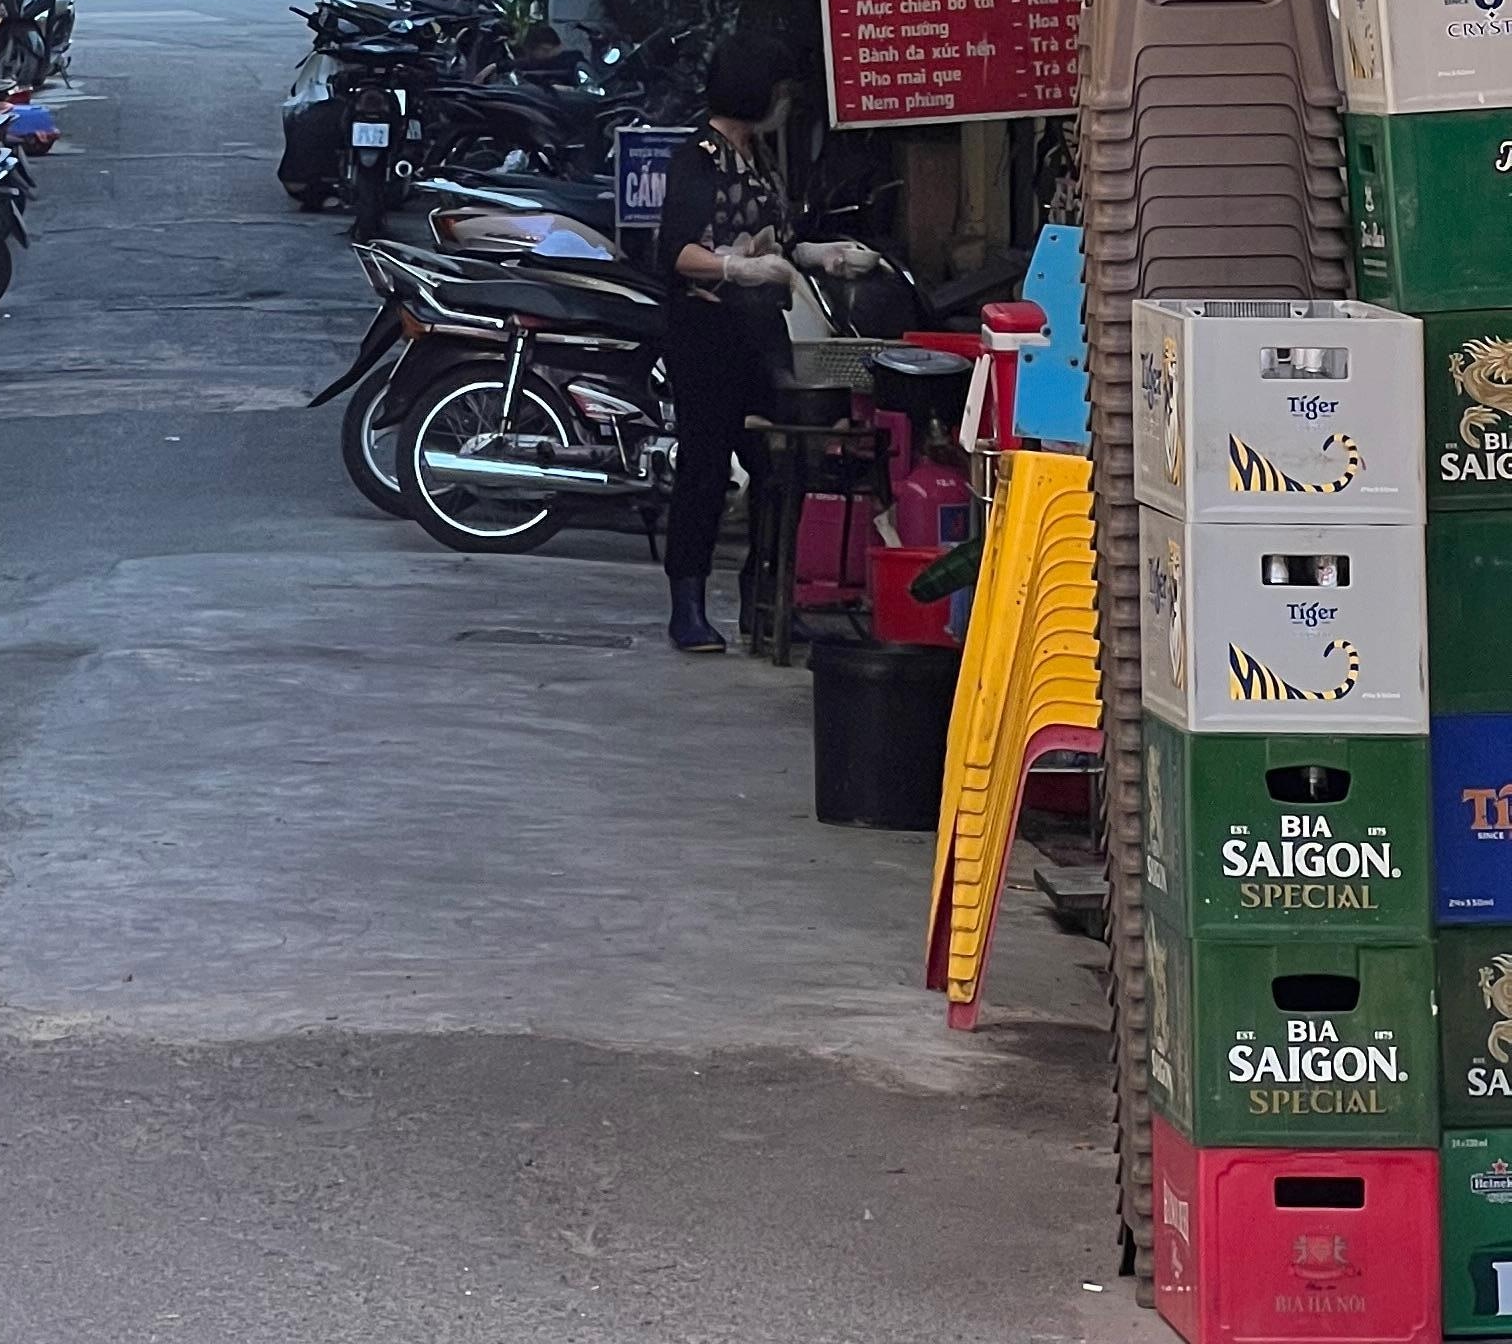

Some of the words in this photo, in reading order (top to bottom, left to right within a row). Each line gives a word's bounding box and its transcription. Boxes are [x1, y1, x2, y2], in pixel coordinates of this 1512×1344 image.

[856, 0, 893, 19] Mực
[1029, 14, 1059, 29] Hoa
[858, 23, 895, 42] Mực
[906, 45, 925, 60] đa
[932, 43, 960, 59] xúc
[1030, 36, 1059, 53] Trà
[1032, 61, 1060, 76] Trà
[897, 69, 926, 85] mai
[933, 70, 961, 87] que
[1034, 84, 1061, 100] Trà
[862, 95, 899, 111] Nem
[1287, 395, 1339, 420] Tiger
[1484, 432, 1512, 450] BI
[1287, 602, 1338, 627] Tiger
[1281, 815, 1332, 838] BIA
[1240, 883, 1379, 909] SPECIAL
[1288, 1020, 1339, 1043] BIA
[1249, 1089, 1389, 1114] SPECIAL
